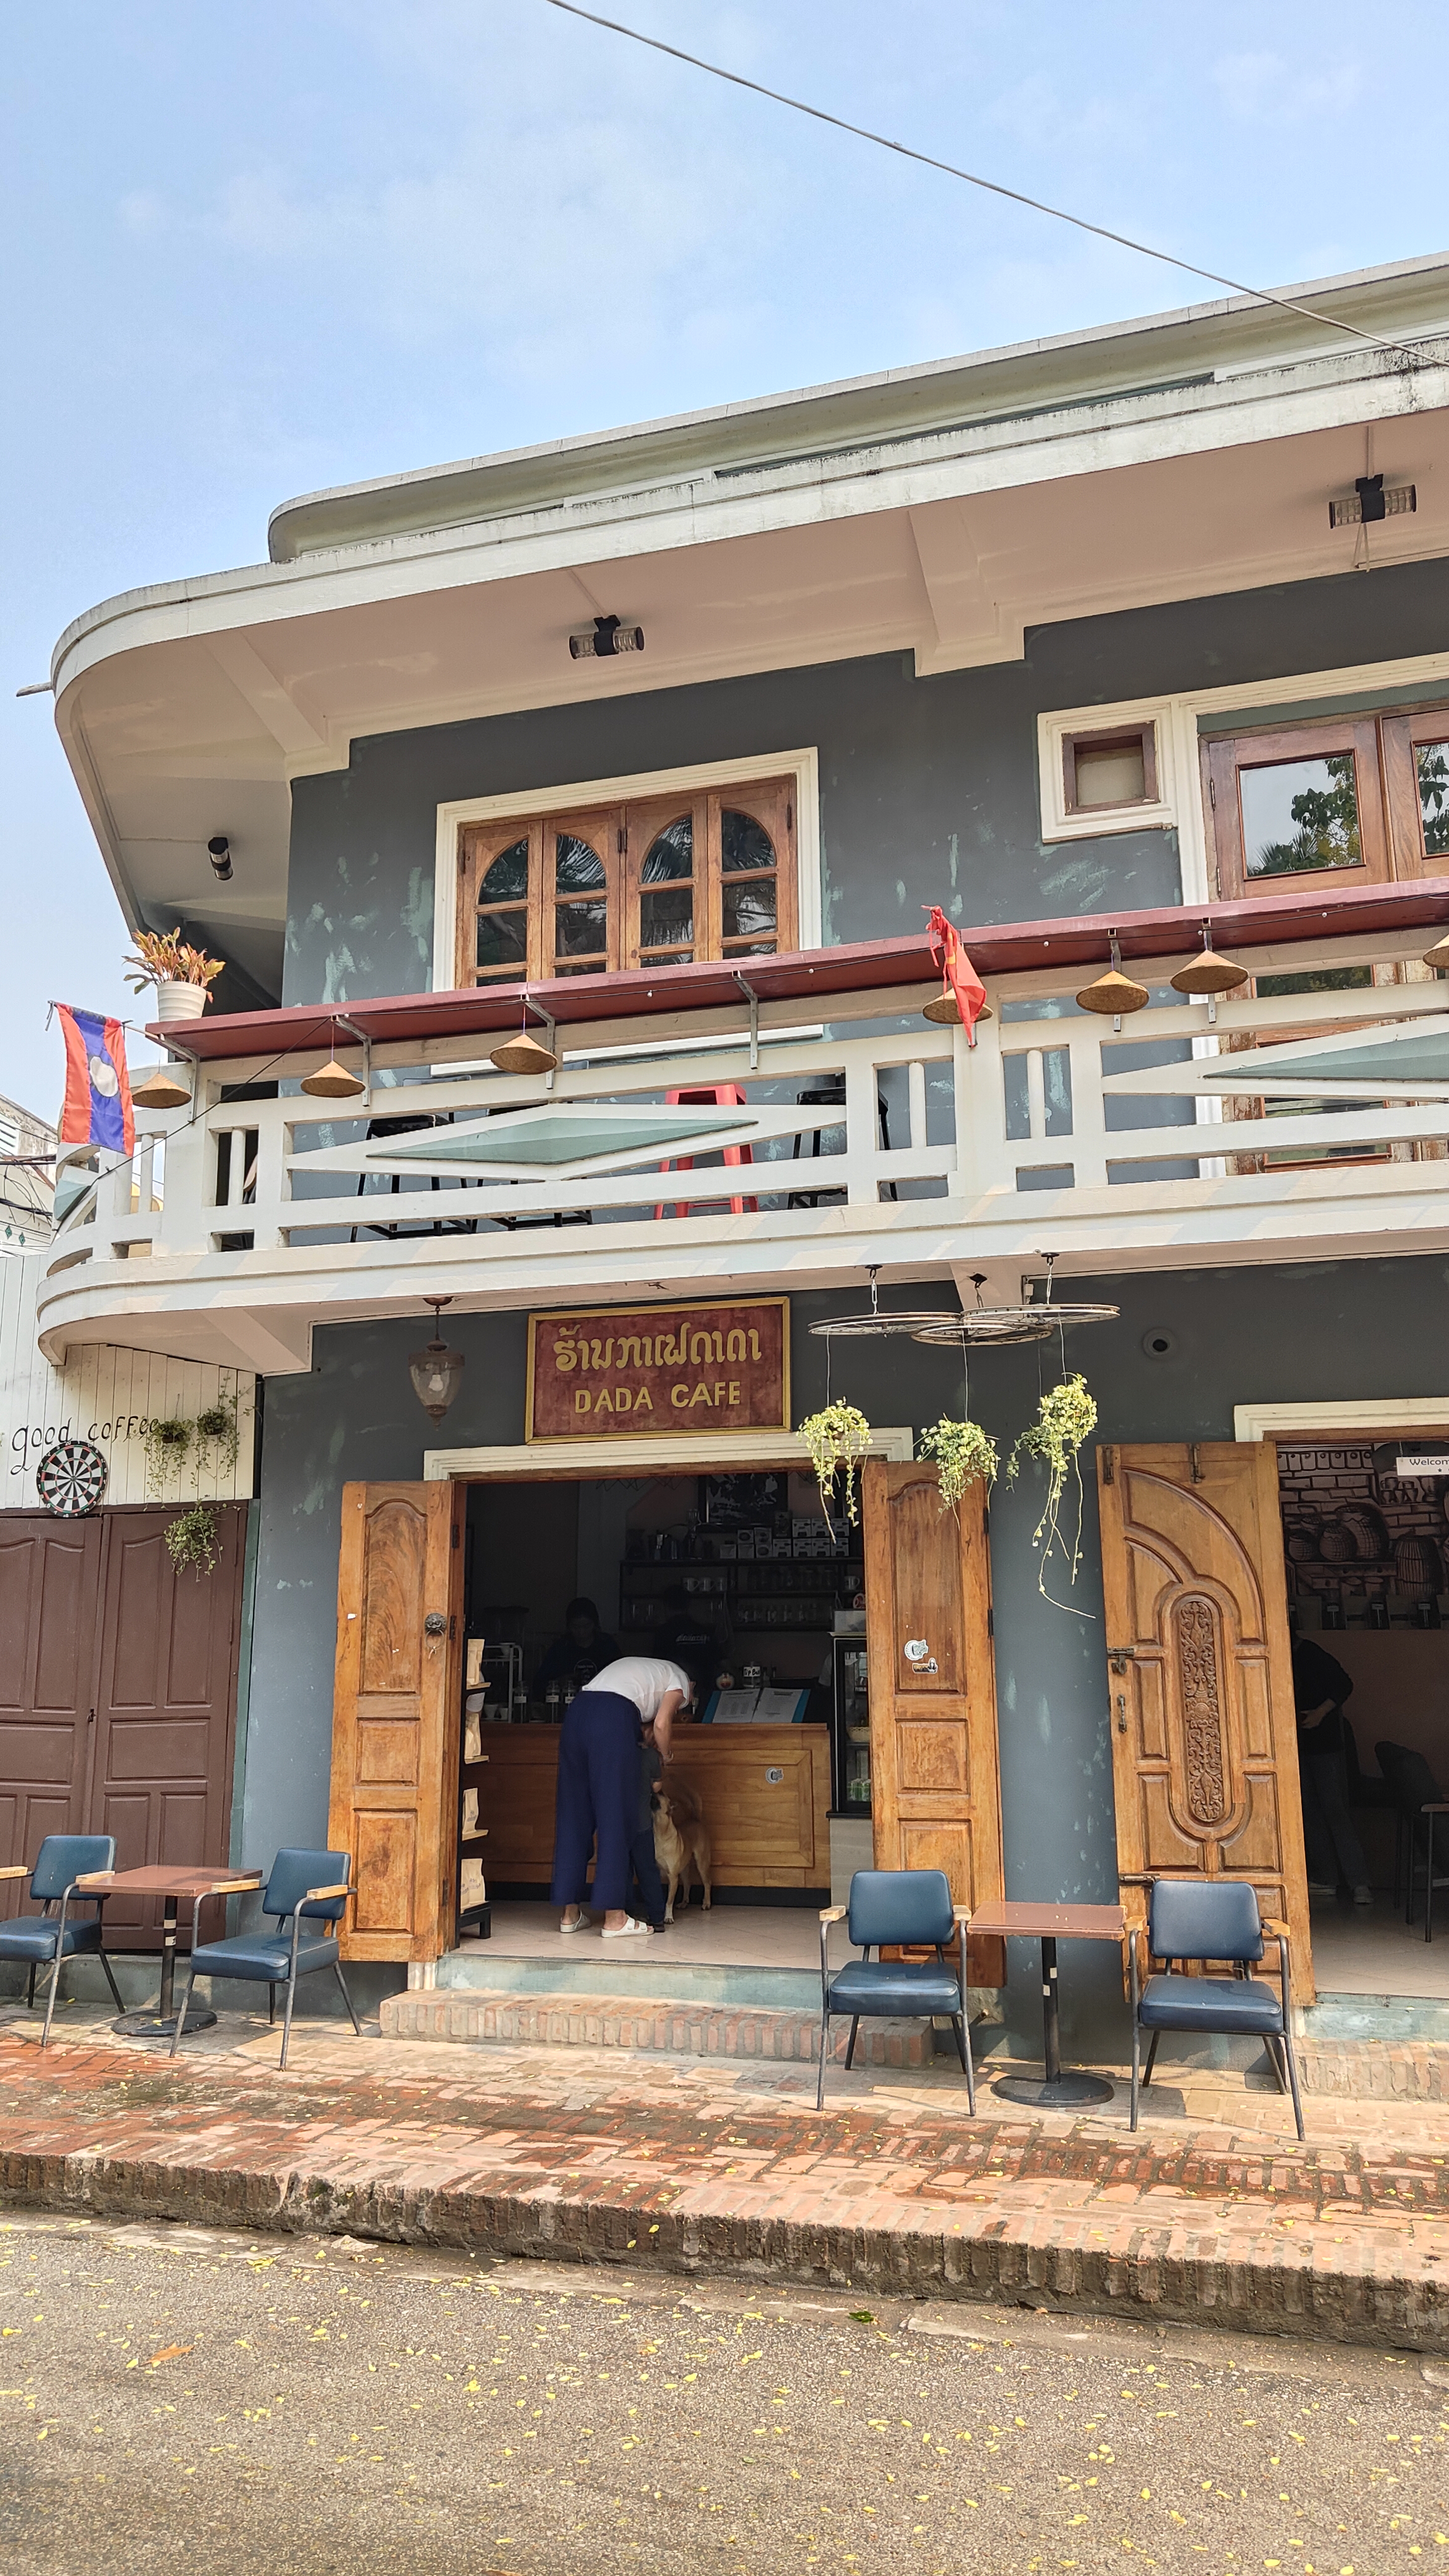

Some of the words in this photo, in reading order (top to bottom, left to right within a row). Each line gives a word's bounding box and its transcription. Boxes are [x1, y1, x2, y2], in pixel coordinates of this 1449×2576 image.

[575, 1386, 653, 1414] DADA
[671, 1381, 741, 1408] CAFE
[10, 1417, 73, 1475] good
[87, 1416, 159, 1443] coffee
